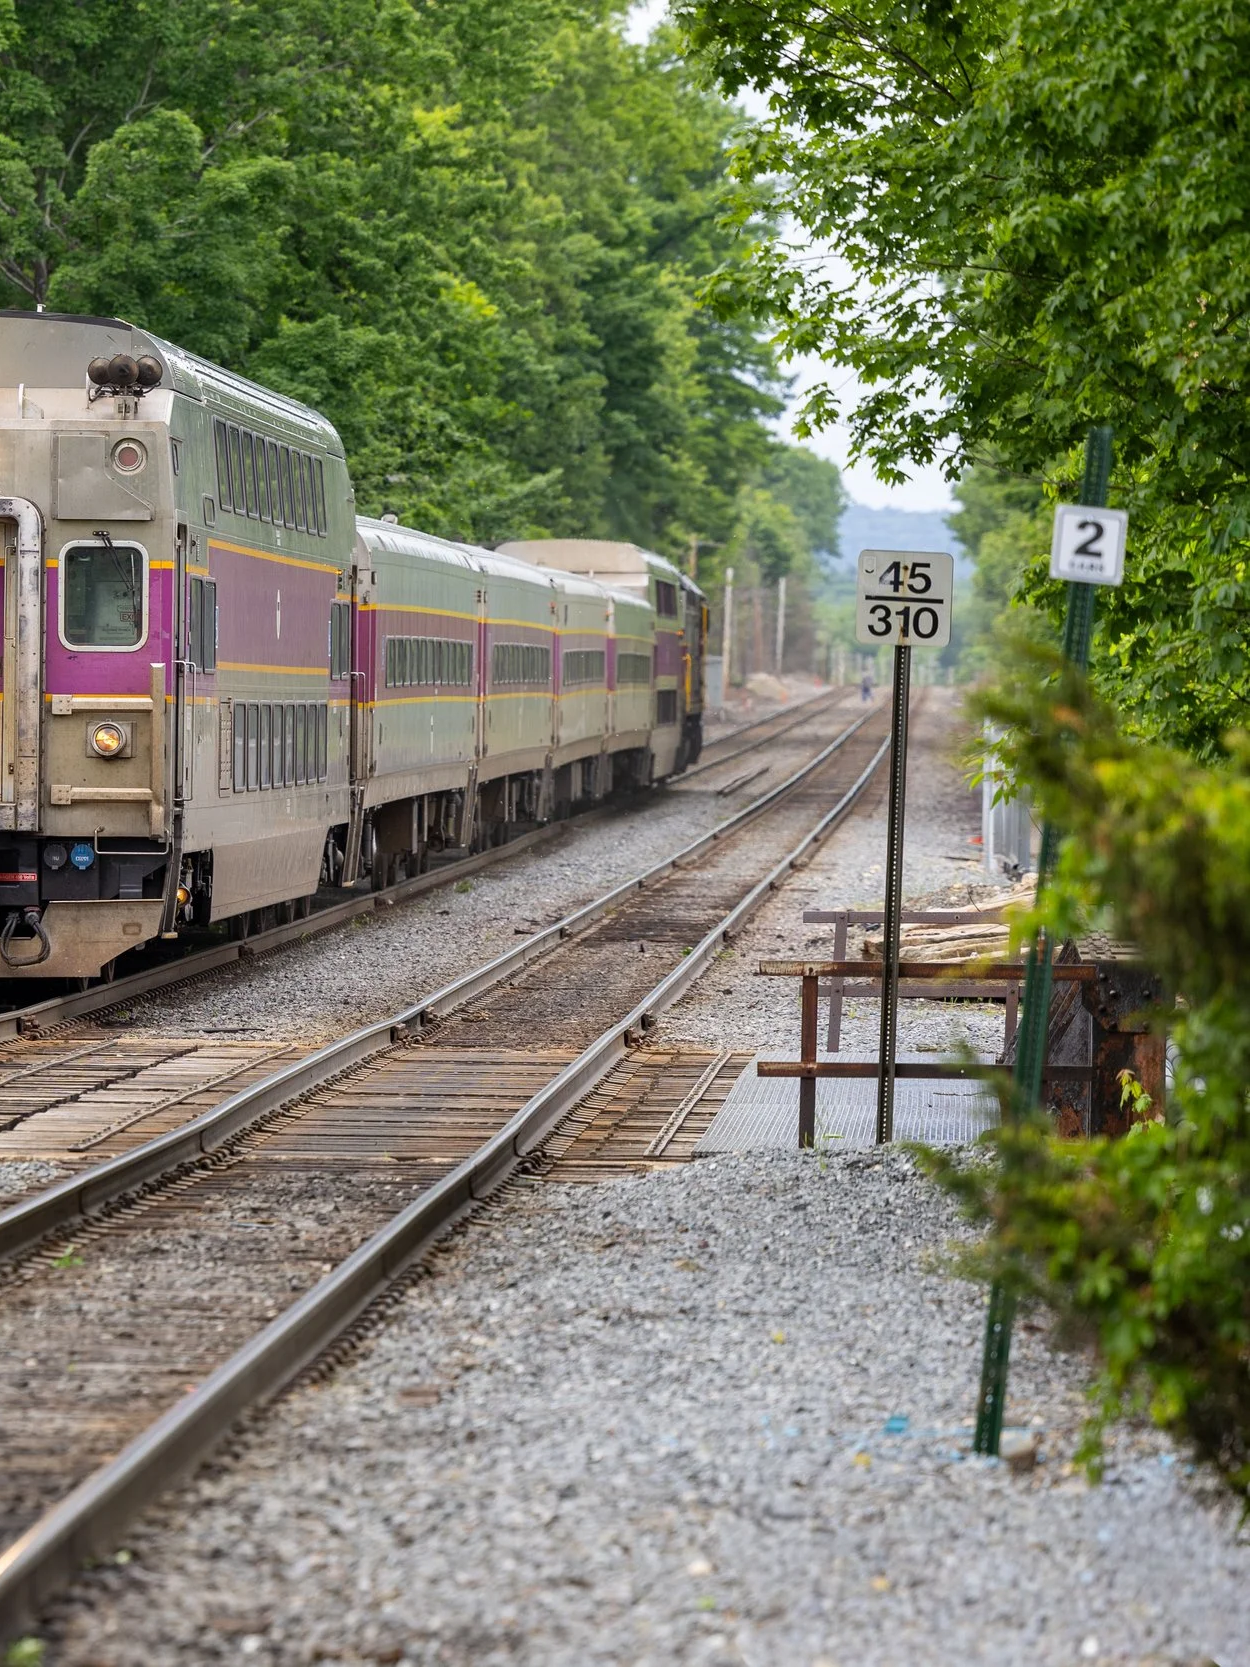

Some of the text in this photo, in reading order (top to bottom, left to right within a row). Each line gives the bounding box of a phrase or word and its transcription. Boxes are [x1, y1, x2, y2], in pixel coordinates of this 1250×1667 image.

[1075, 521, 1103, 558] 2
[879, 561, 932, 594] 45
[868, 604, 939, 639] 310
